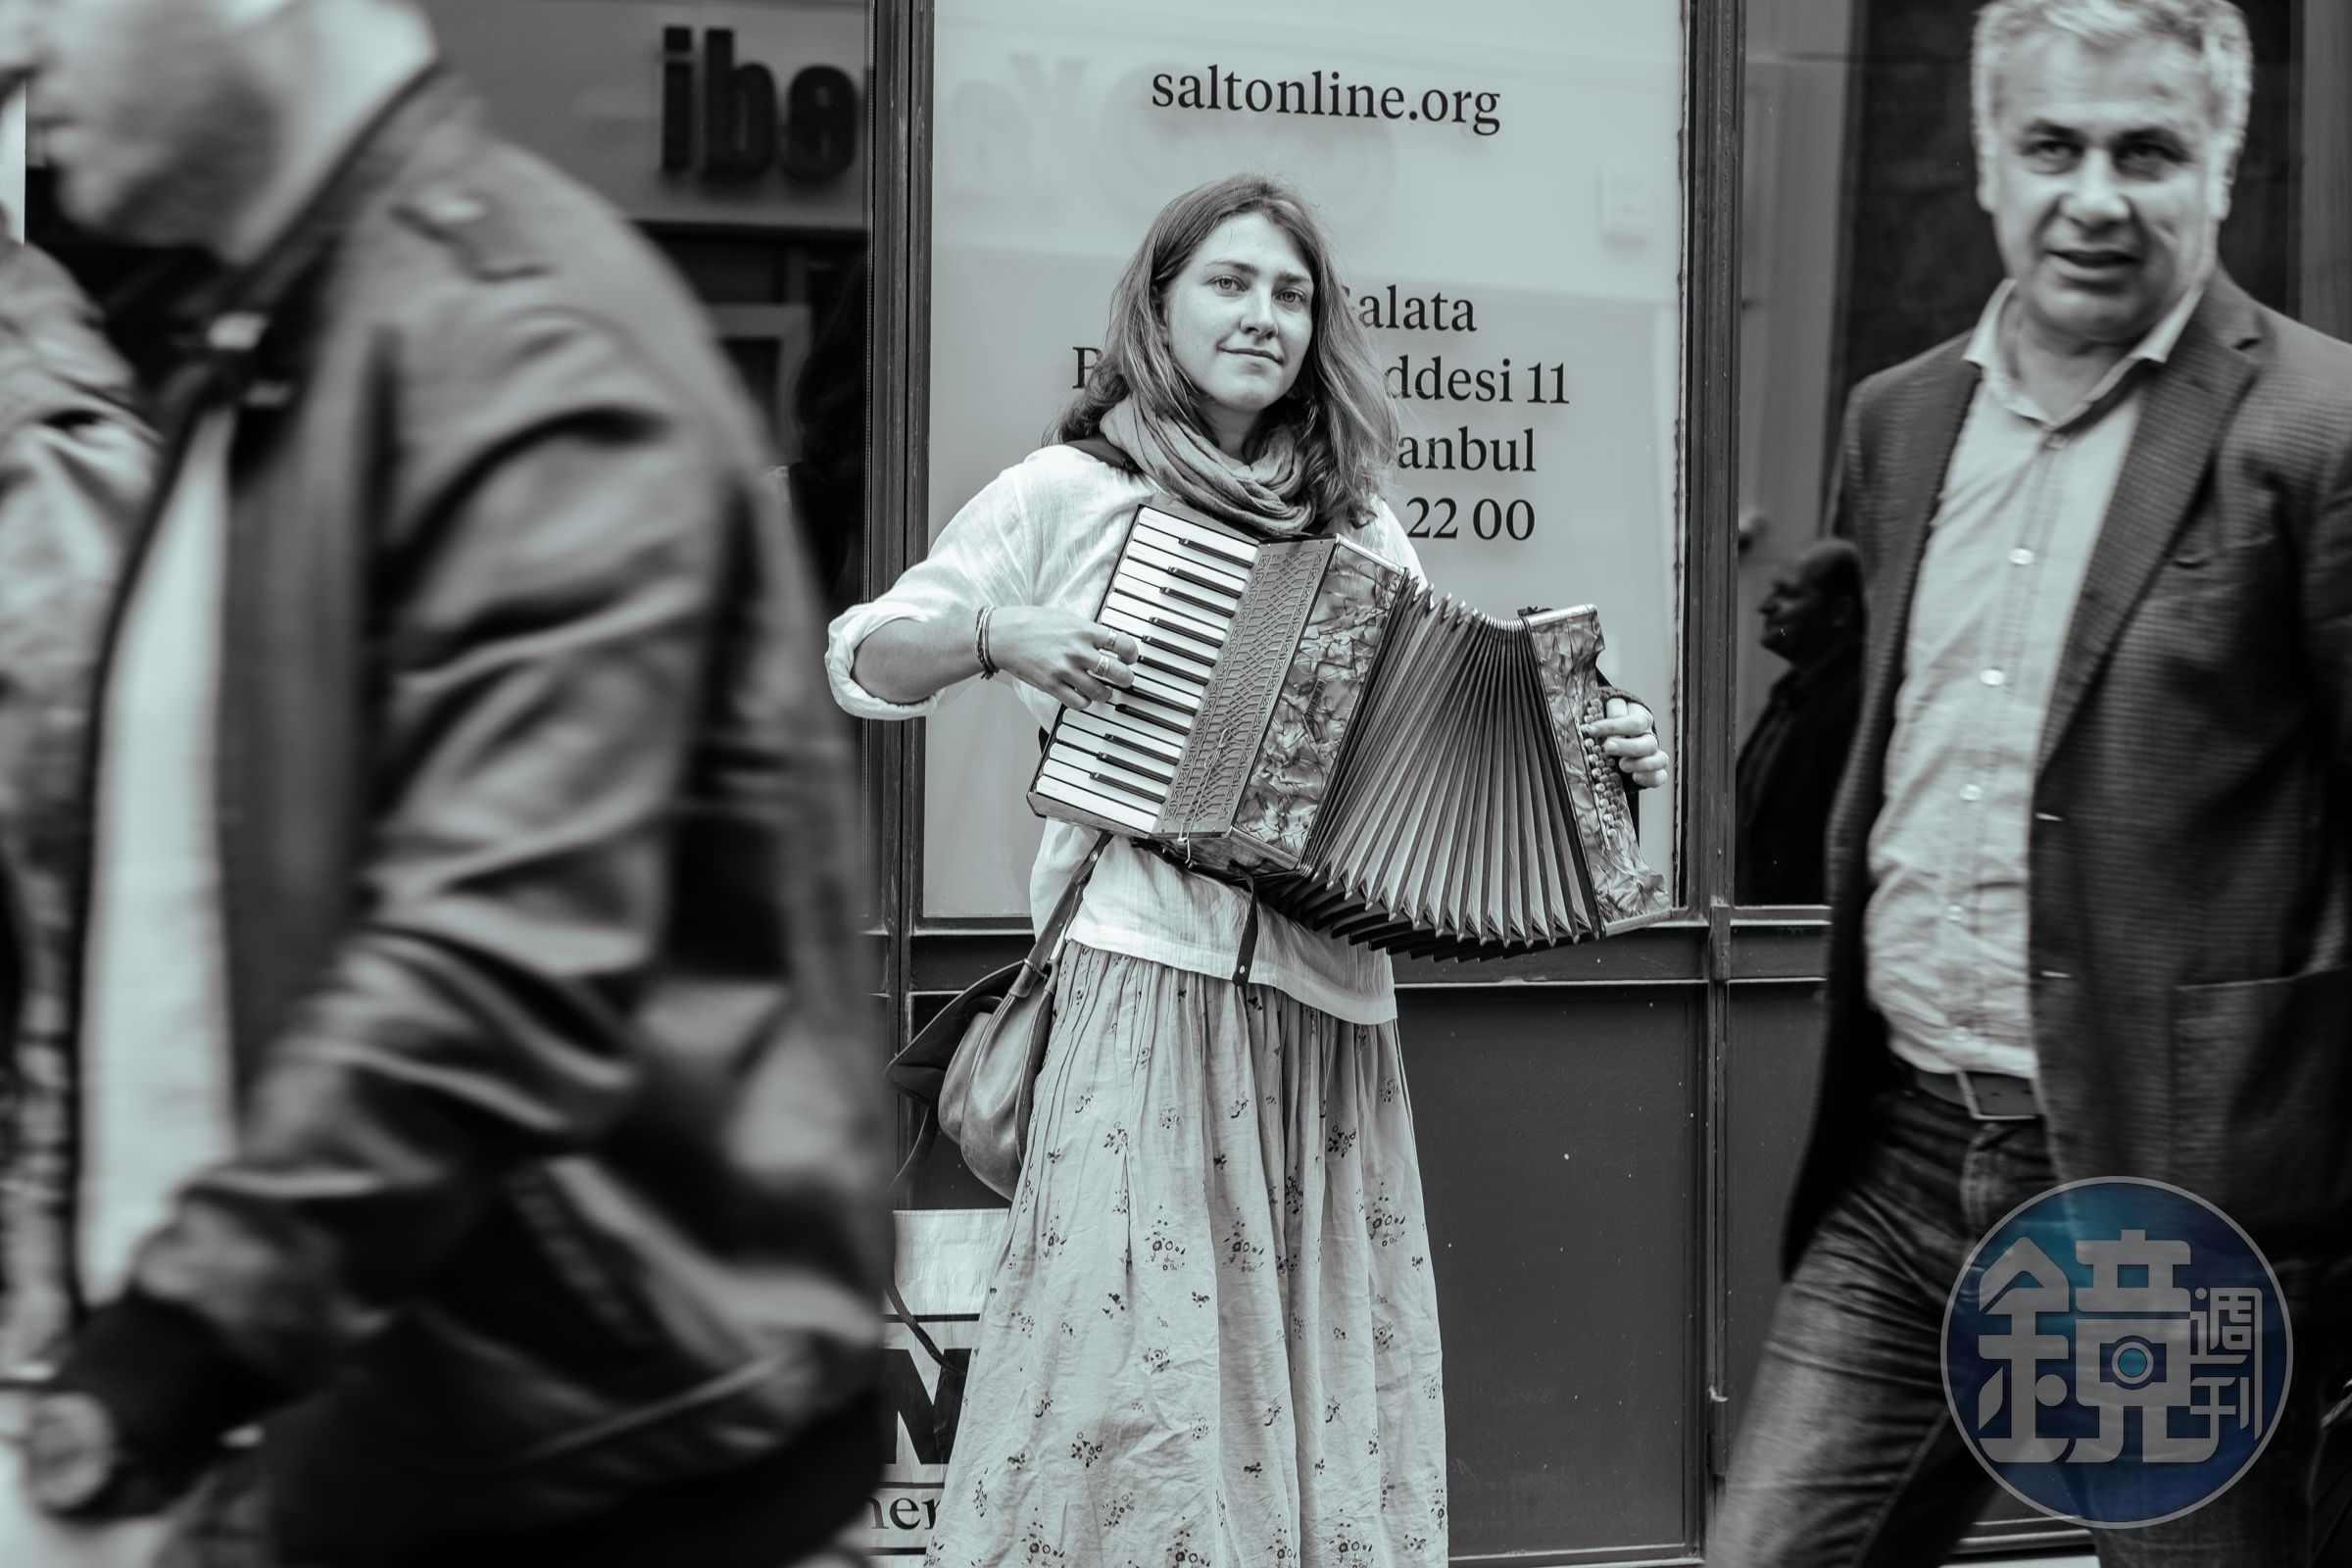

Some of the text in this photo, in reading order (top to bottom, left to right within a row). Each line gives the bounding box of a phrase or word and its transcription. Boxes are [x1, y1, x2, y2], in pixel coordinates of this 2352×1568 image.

[1151, 63, 1501, 136] saltonline.org
[1343, 283, 1478, 332] alata
[1384, 354, 1570, 405] ddesi 11
[1397, 425, 1538, 472] anbul
[1405, 496, 1537, 542] 22 00
